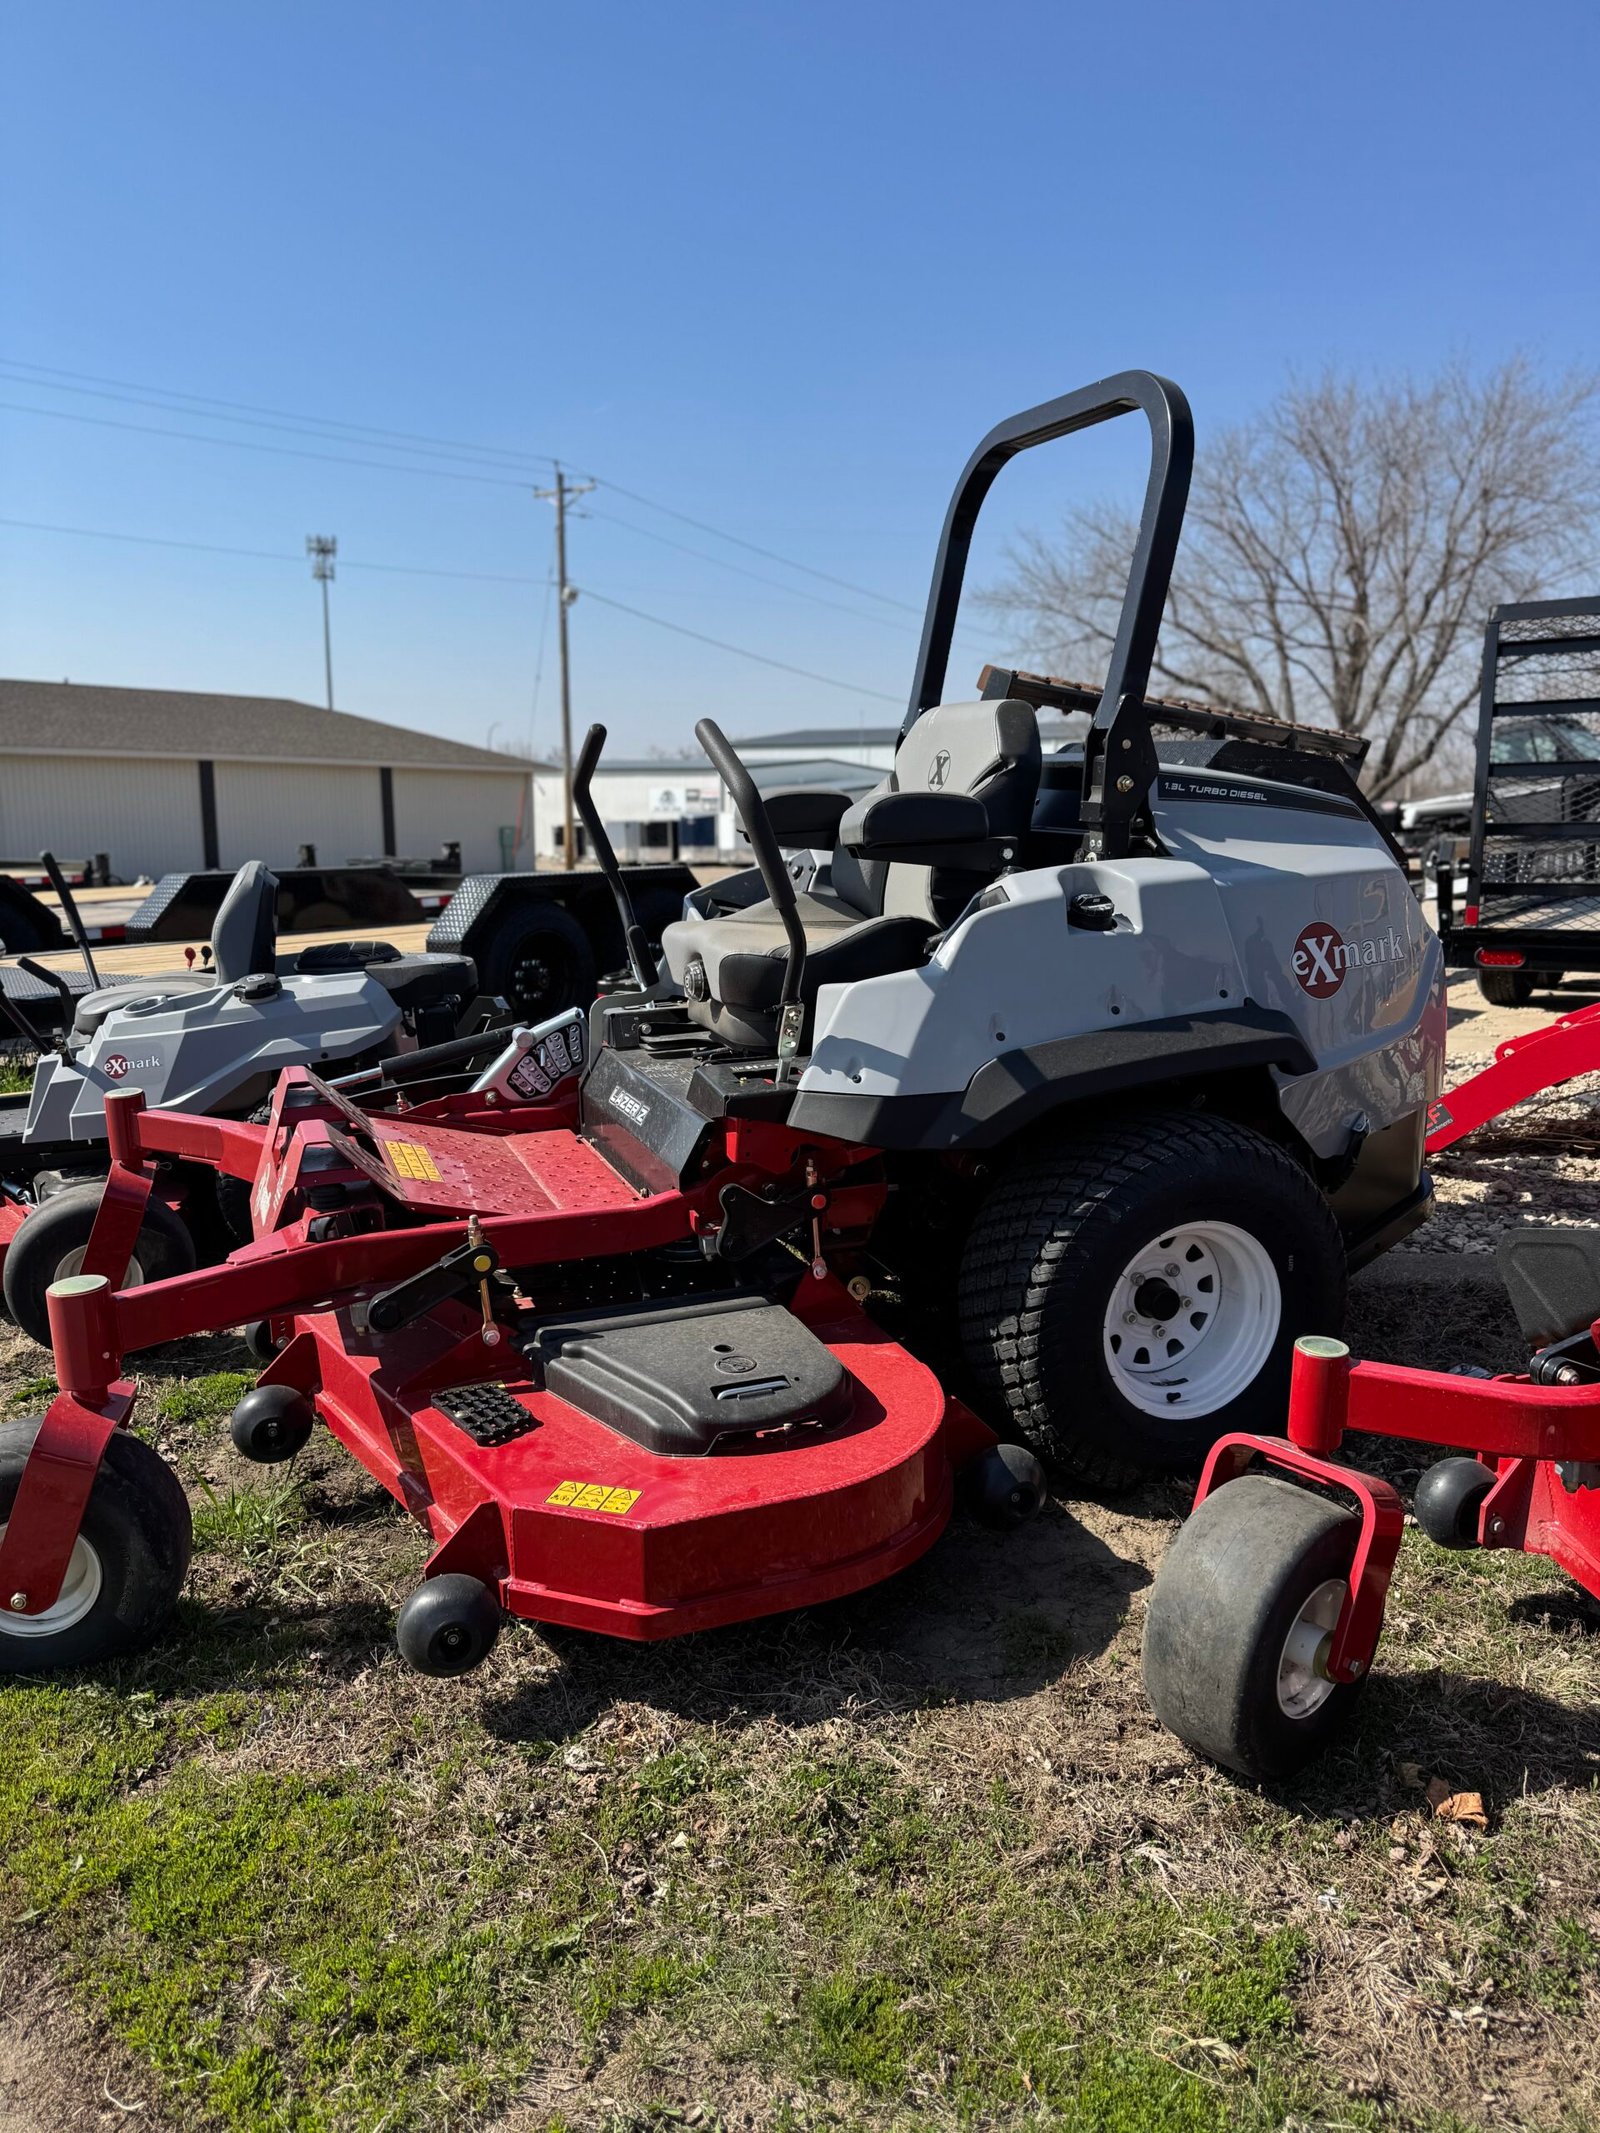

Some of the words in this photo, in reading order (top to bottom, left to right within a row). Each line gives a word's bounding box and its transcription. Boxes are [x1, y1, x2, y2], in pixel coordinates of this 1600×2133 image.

[1164, 782, 1186, 792] 1.3L
[1189, 785, 1227, 796] TURBO
[1229, 789, 1268, 801] DIESEL
[1291, 926, 1405, 987] eXmark
[104, 1055, 160, 1076] eXmark
[609, 1086, 642, 1121] LAZER
[635, 1105, 650, 1126] Z
